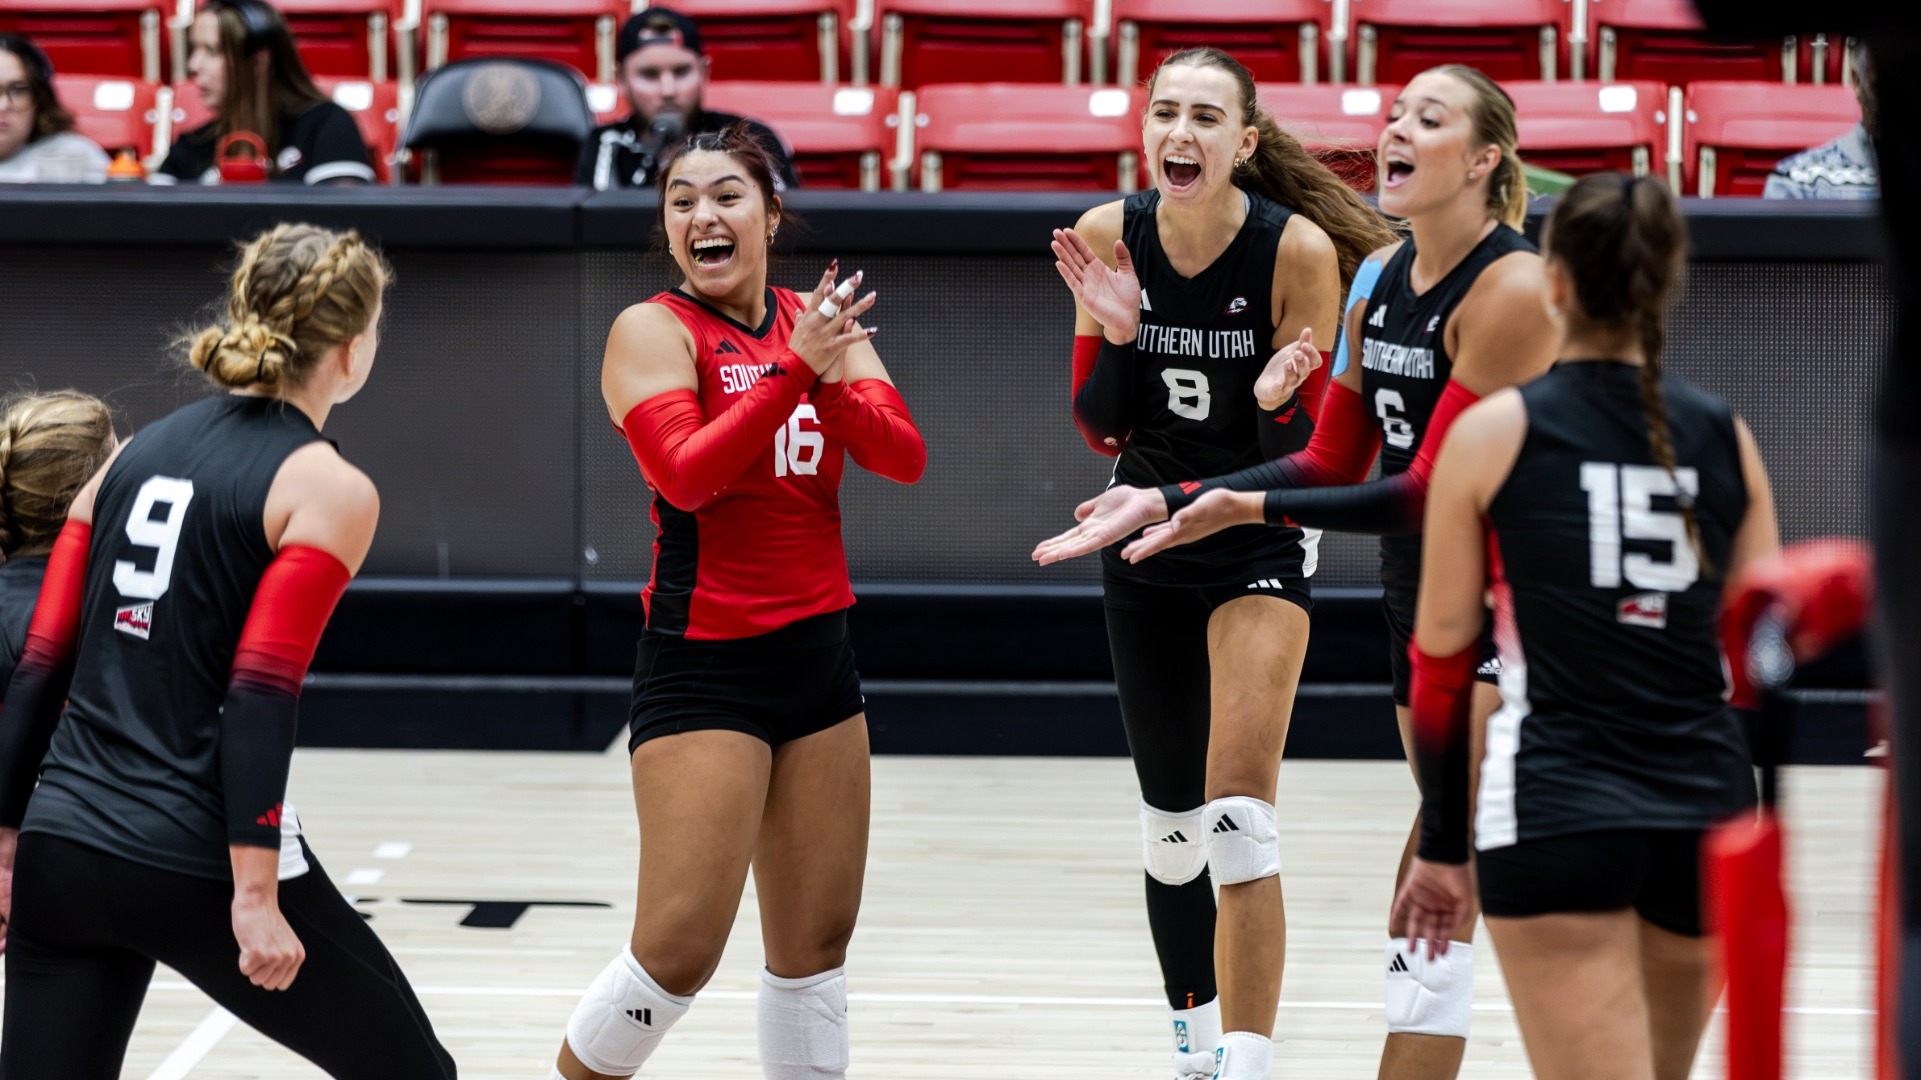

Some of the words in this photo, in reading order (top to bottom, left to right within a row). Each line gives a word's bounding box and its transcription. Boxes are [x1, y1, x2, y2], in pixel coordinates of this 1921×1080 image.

[1137, 323, 1203, 357] UTHERN
[1208, 329, 1255, 359] UTAH
[1161, 368, 1211, 421] 8
[1375, 388, 1414, 450] 6
[775, 404, 824, 477] 16
[112, 475, 194, 600] 9
[1580, 461, 1699, 592] 15
